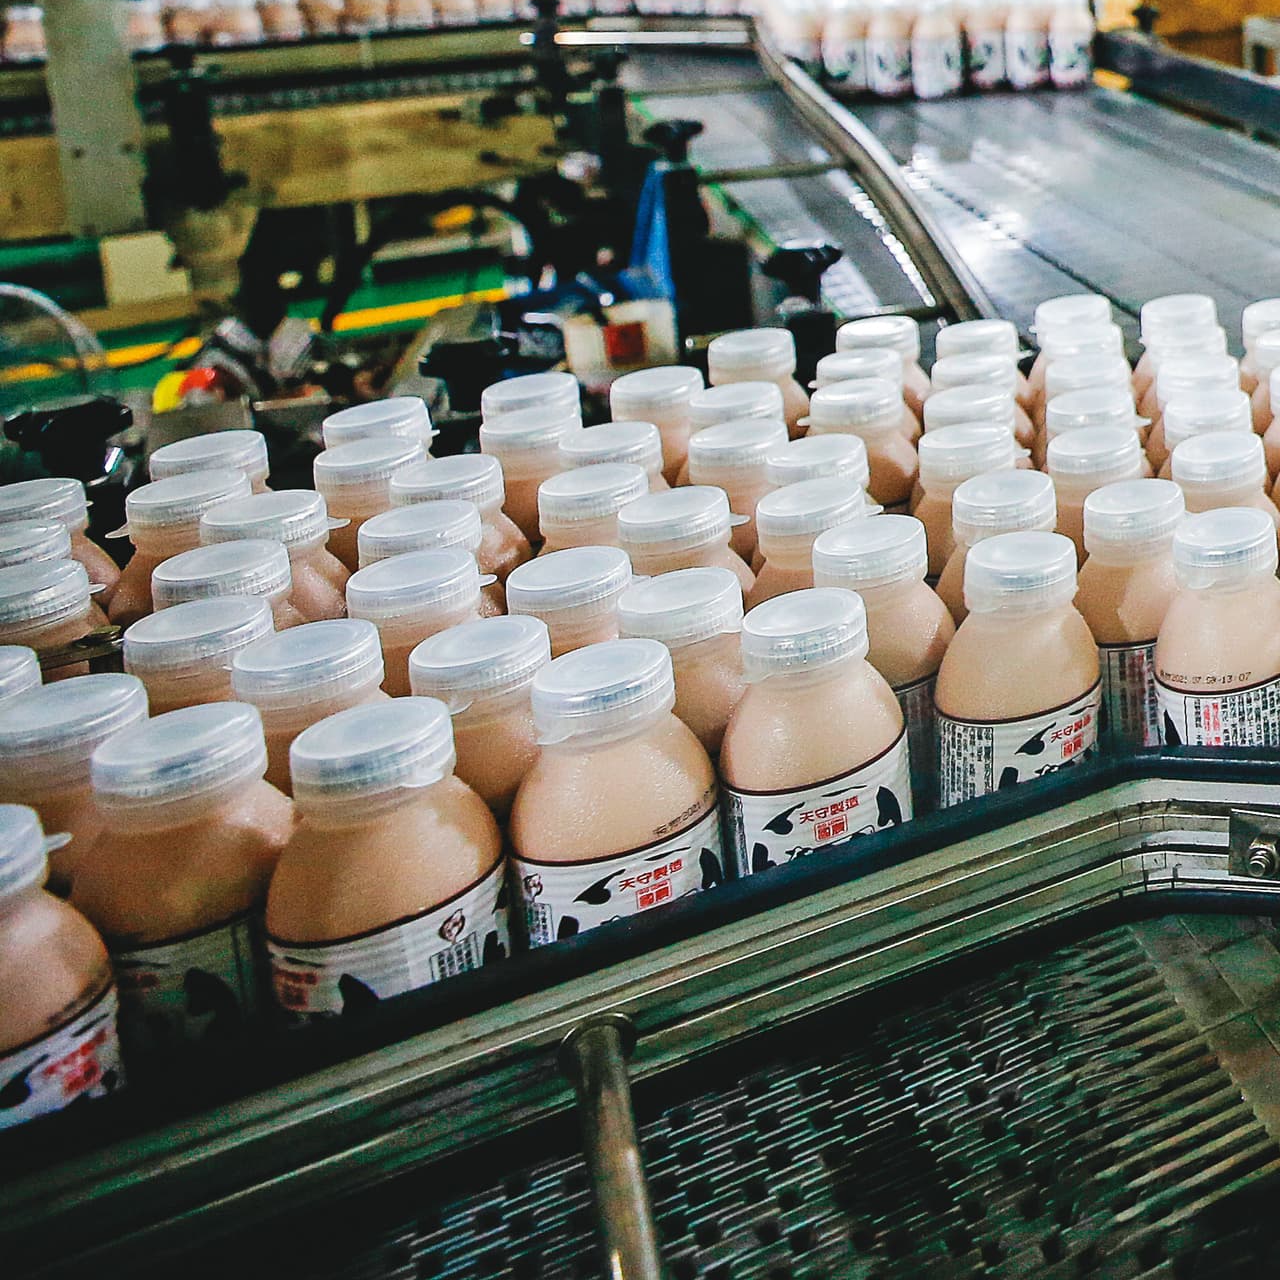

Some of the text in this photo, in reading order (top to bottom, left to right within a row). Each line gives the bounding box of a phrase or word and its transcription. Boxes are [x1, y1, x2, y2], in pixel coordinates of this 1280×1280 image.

[799, 795, 859, 825] 天守製造
[618, 858, 683, 892] 天守製造
